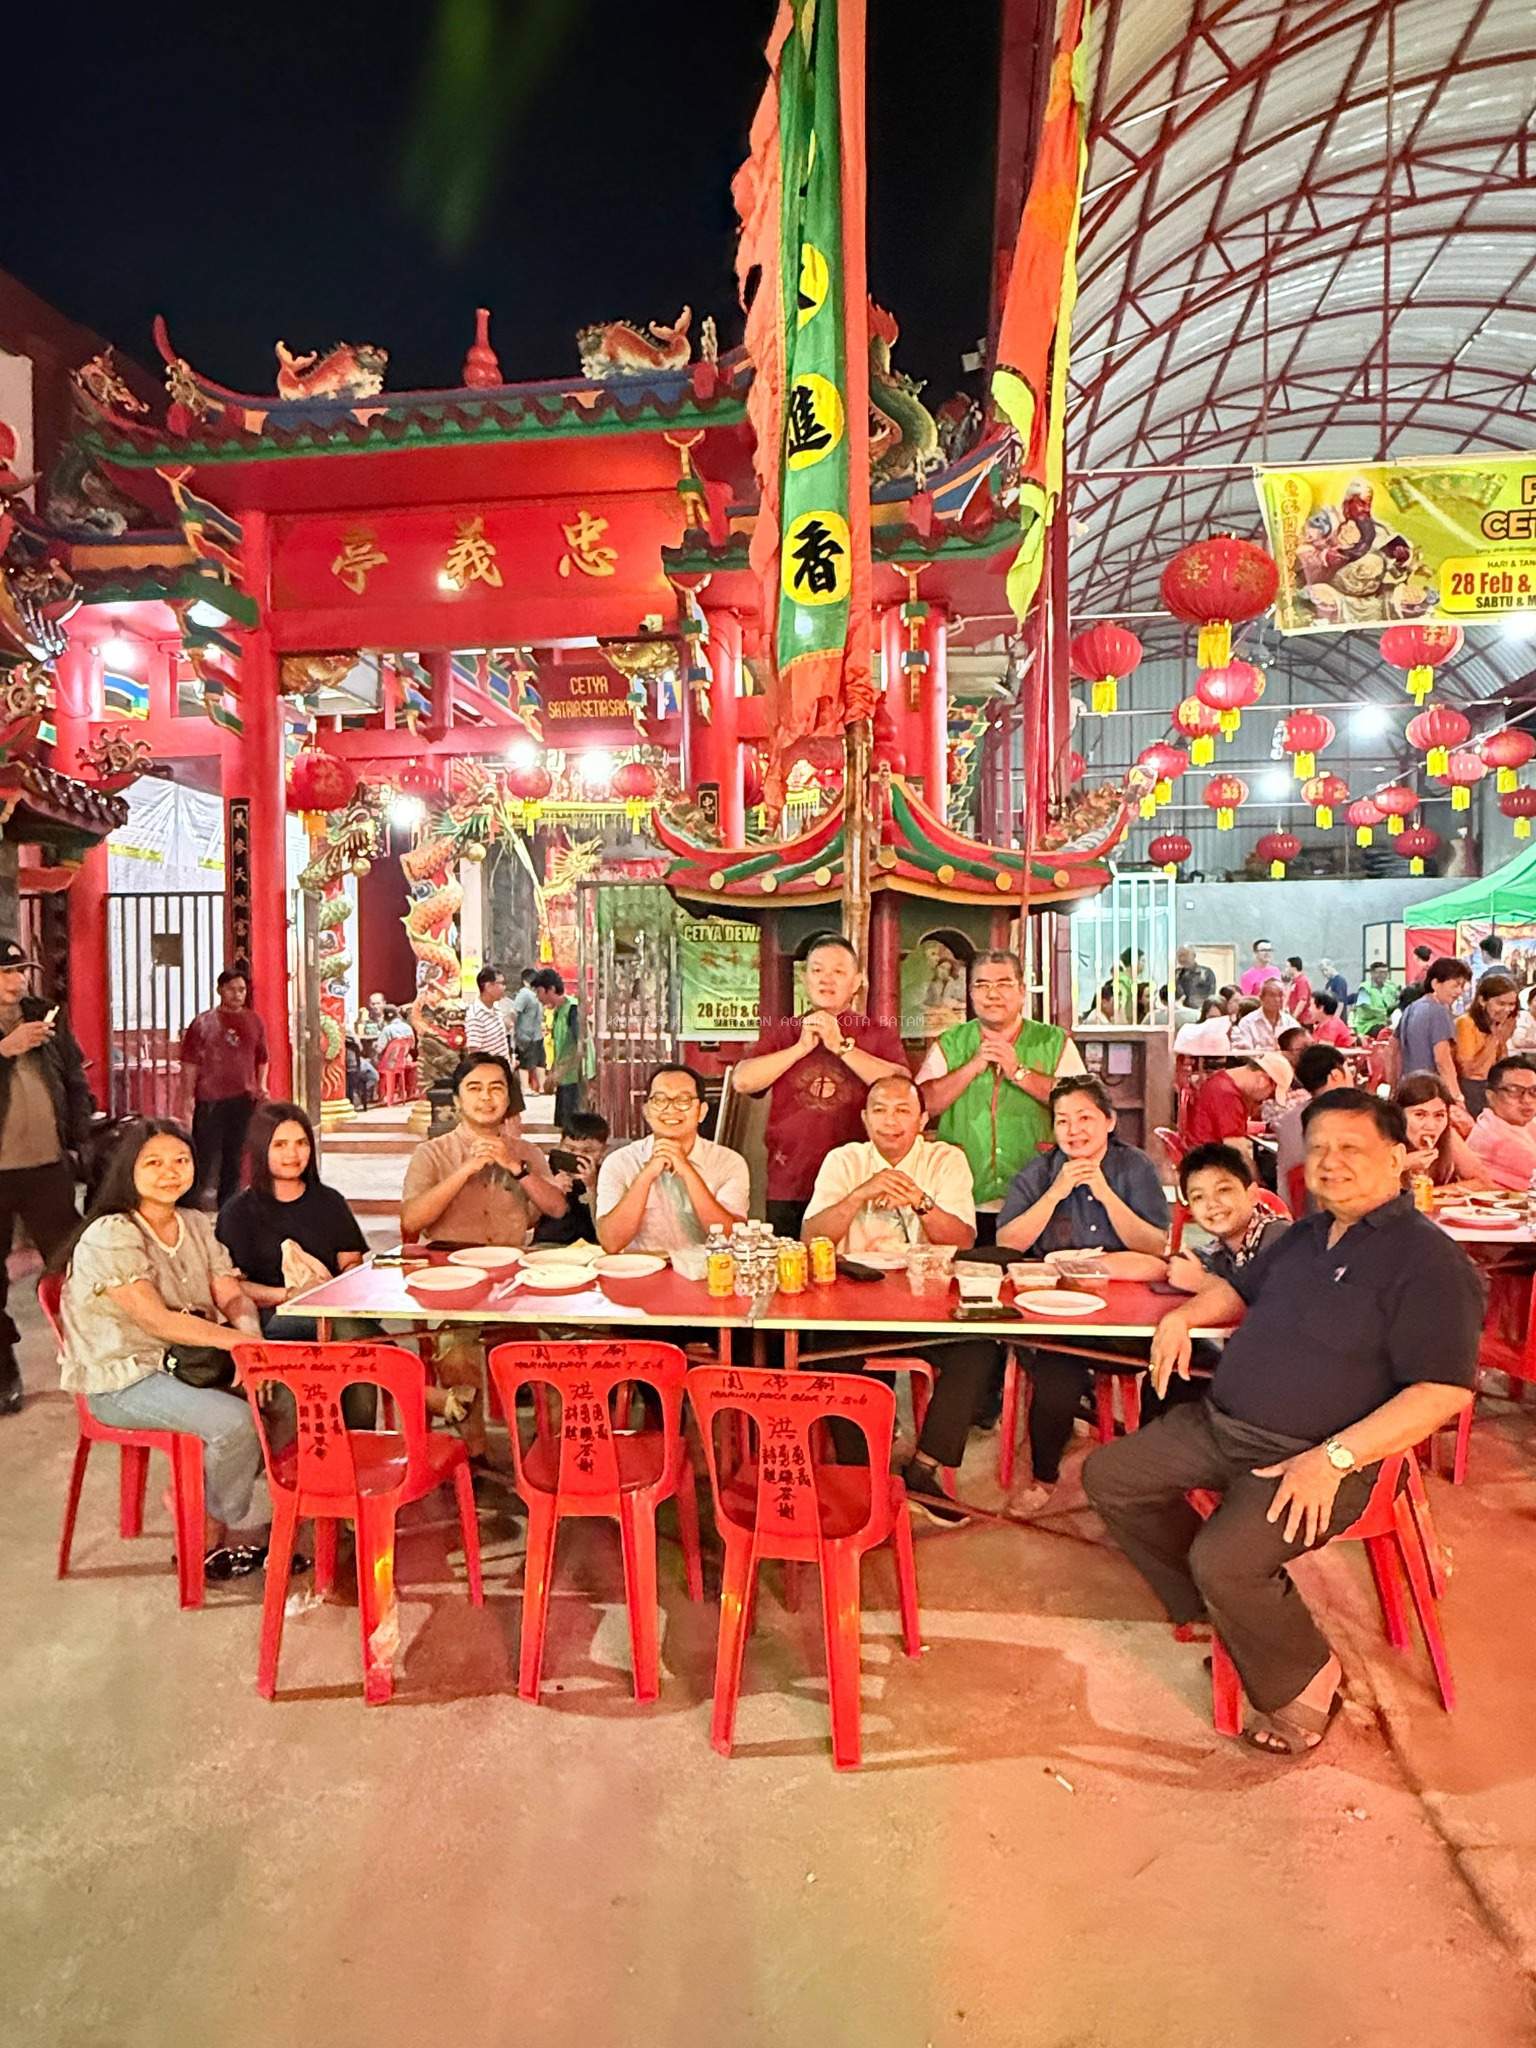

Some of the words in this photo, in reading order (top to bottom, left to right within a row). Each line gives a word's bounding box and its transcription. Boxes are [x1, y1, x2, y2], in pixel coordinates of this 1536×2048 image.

[1451, 573, 1475, 595] 28
[1480, 571, 1513, 594] Feb
[1518, 574, 1531, 592] &
[1476, 595, 1513, 608] SABTU
[570, 676, 609, 695] CETYA
[684, 925, 722, 942] CETYA
[698, 1003, 713, 1018] 28
